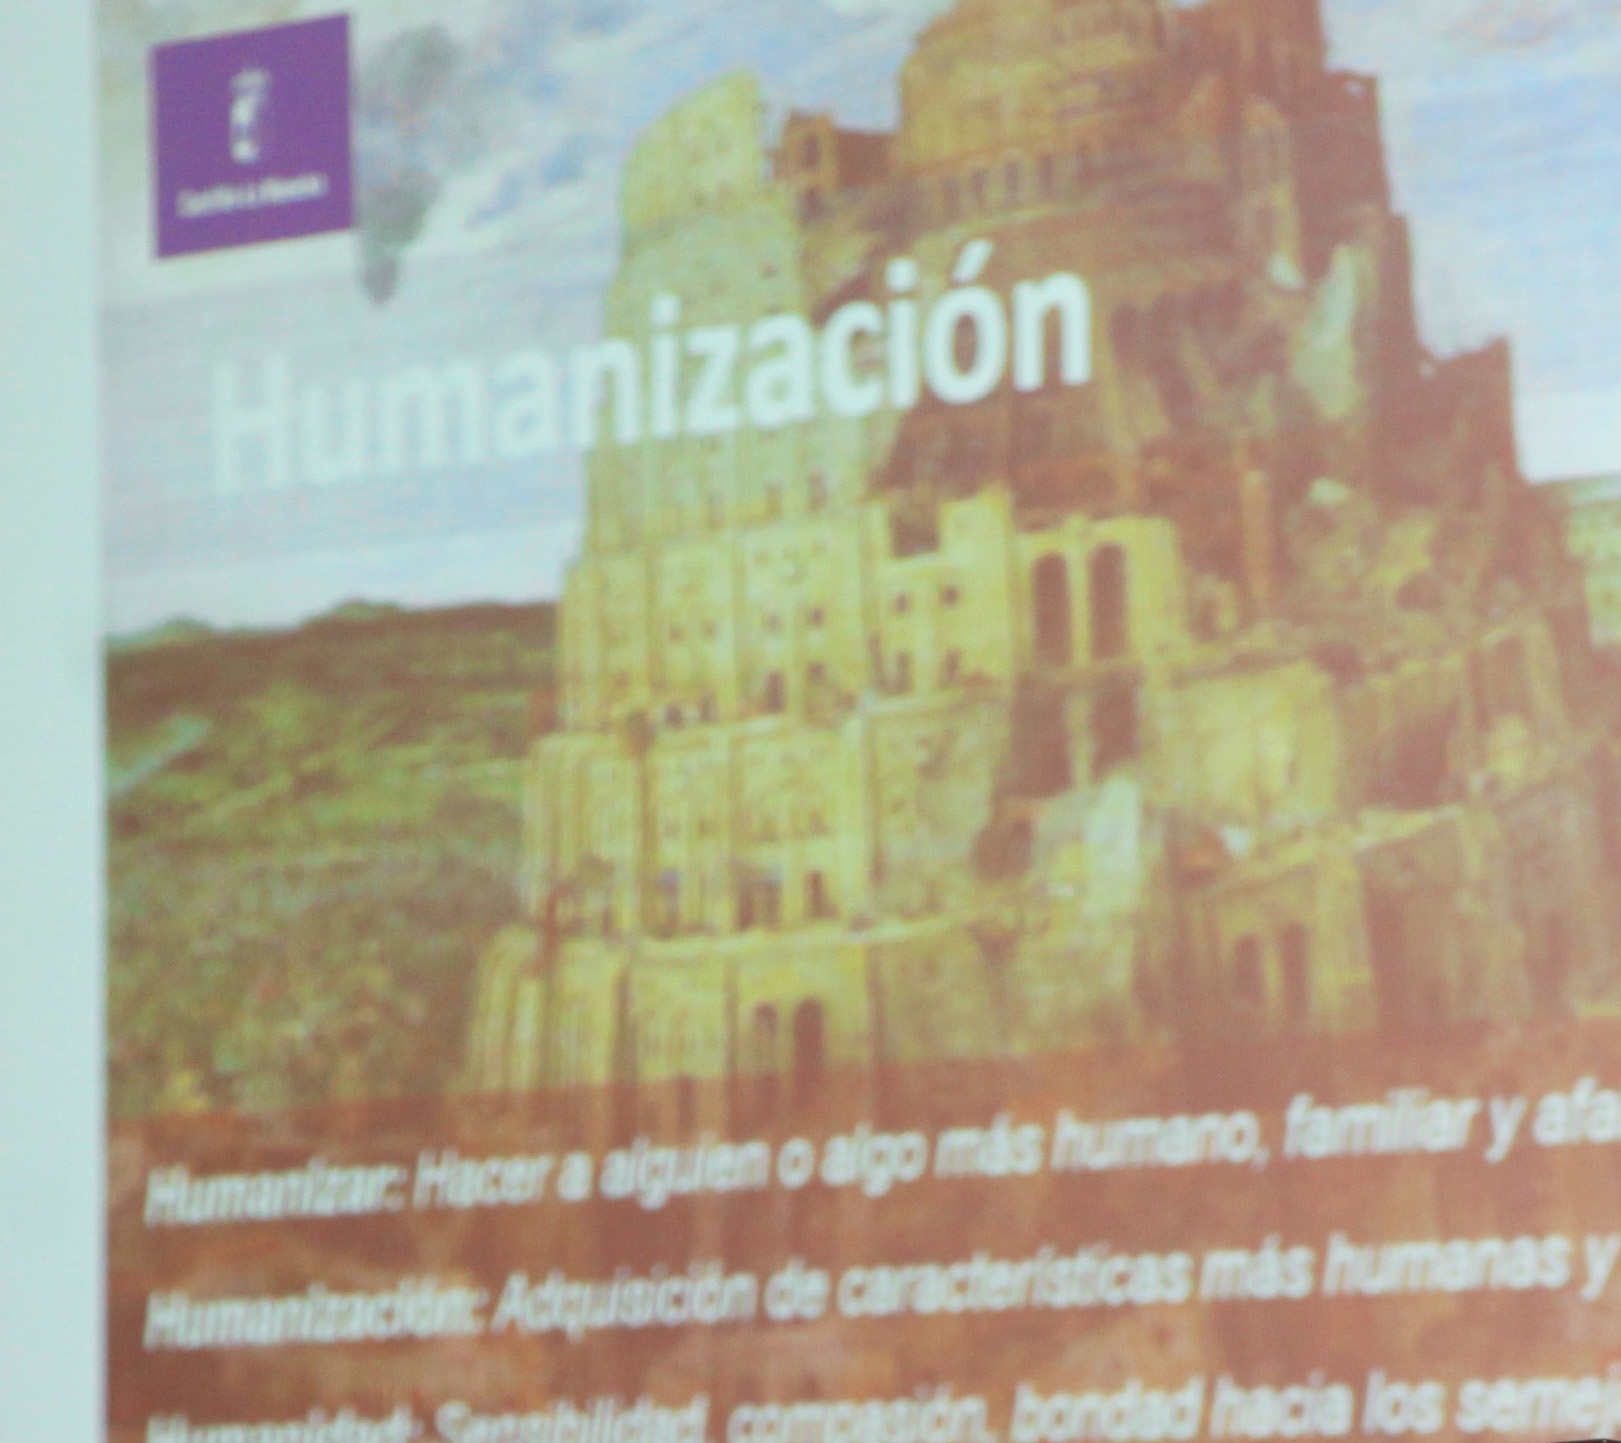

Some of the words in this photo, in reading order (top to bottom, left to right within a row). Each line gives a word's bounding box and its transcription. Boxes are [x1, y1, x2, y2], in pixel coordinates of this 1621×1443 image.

[214, 238, 1094, 496] Humanización
[144, 1153, 408, 1228] Humanizar:
[413, 1149, 557, 1210] Hacer
[557, 1150, 593, 1203] a
[600, 1134, 770, 1211] alguien
[777, 1136, 814, 1189] o
[820, 1120, 929, 1199] algo
[933, 1111, 1045, 1179] más
[1050, 1107, 1271, 1173] humano,
[1282, 1086, 1481, 1160] familiar
[1484, 1090, 1527, 1165] y
[143, 1276, 487, 1352] Humanización:
[491, 1259, 757, 1345] Adquisición
[763, 1255, 832, 1321] de
[836, 1241, 1193, 1318] características
[1199, 1233, 1315, 1301] más
[1322, 1229, 1572, 1297] humanas
[1577, 1231, 1621, 1301] y
[1209, 1371, 1355, 1440] hacia
[1361, 1368, 1448, 1437] los
